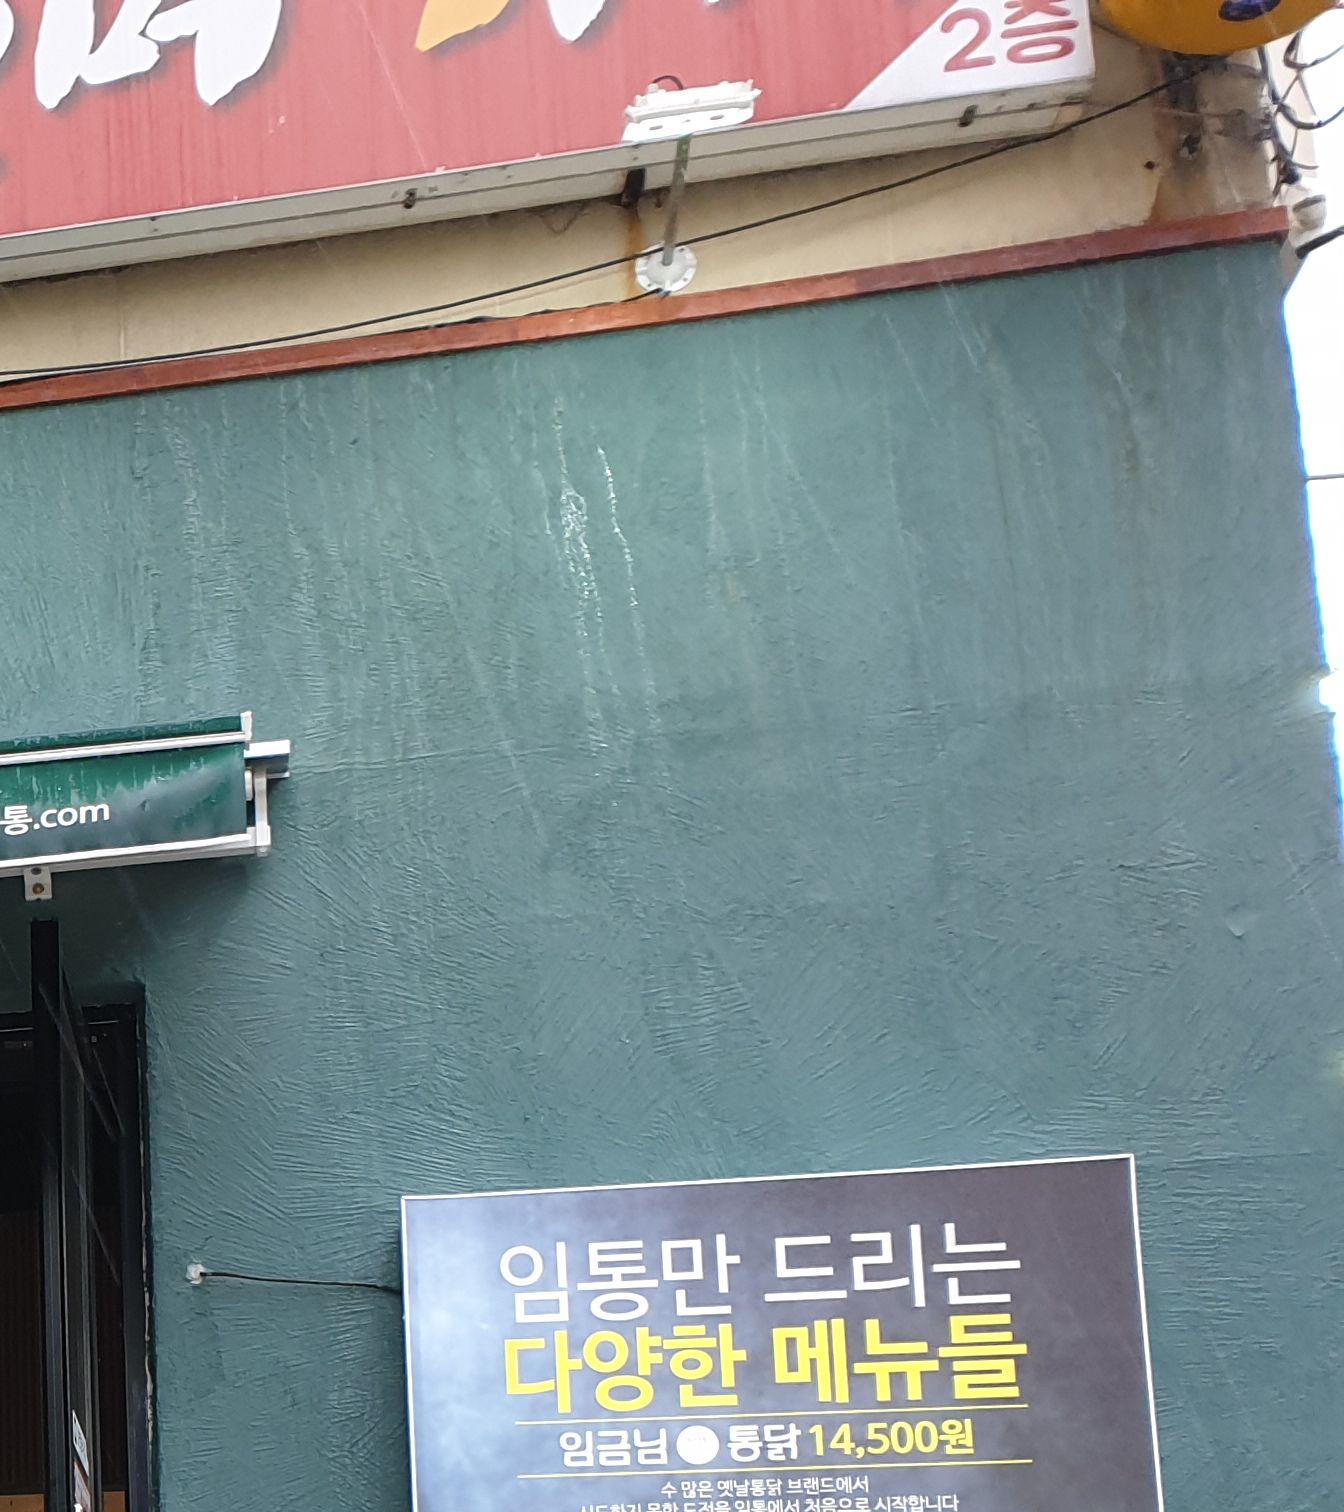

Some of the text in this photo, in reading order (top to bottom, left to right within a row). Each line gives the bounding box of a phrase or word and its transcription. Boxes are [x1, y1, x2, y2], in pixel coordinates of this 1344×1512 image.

[500, 1223, 1022, 1323] 임통만 드리는
[503, 1313, 1028, 1413] 다양한 메뉴들
[558, 1418, 975, 1467] 임금님 통닭 14,500원
[660, 1475, 869, 1498] 수 많은 옛날통닭 브랜드에서
